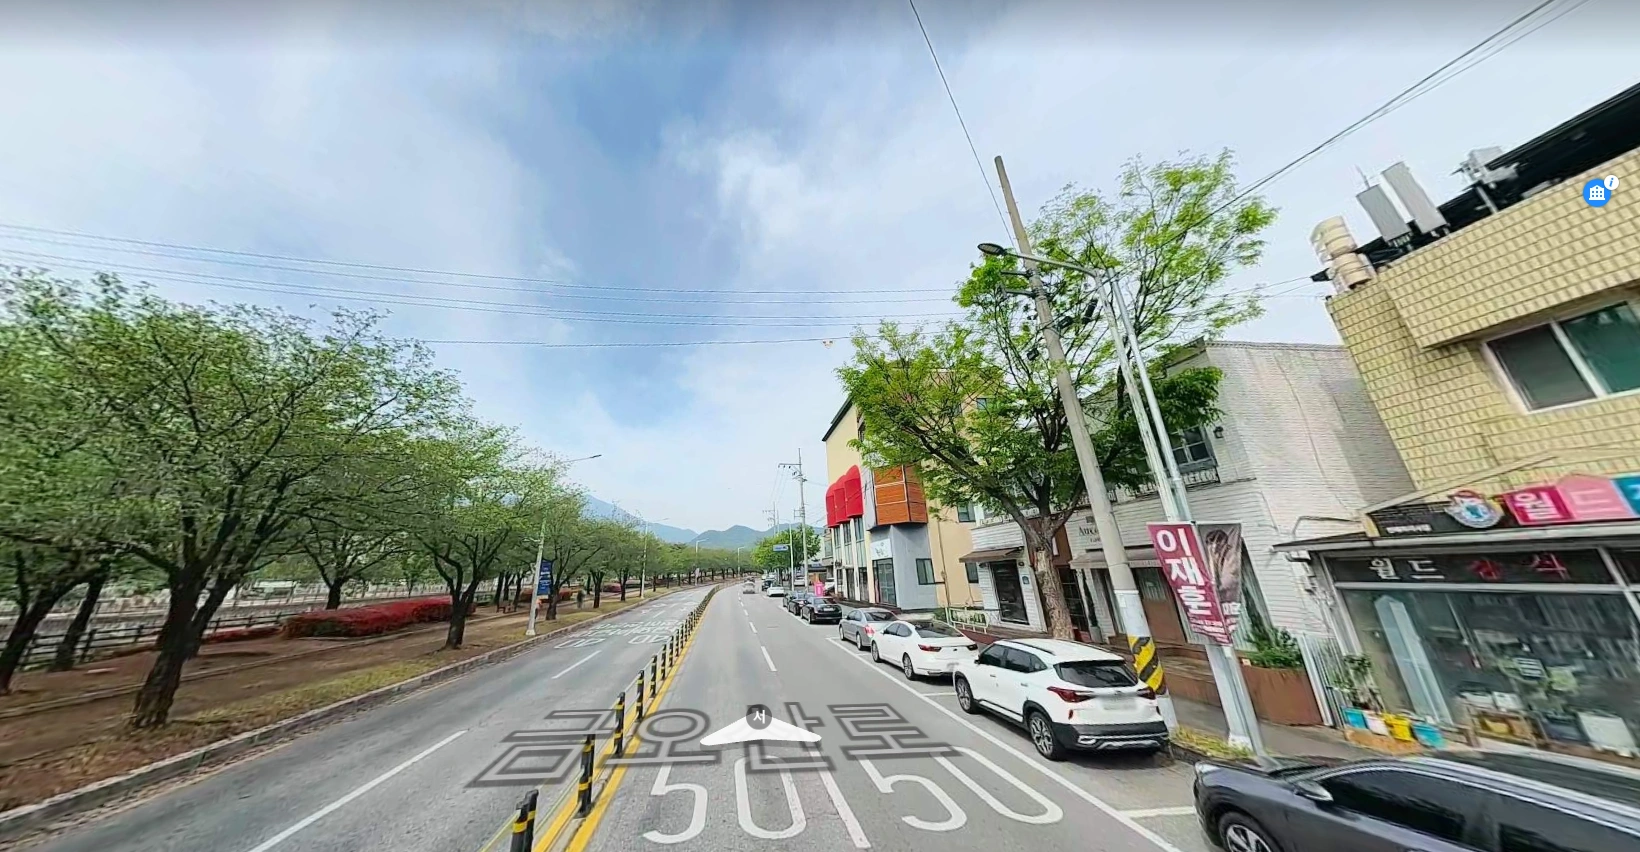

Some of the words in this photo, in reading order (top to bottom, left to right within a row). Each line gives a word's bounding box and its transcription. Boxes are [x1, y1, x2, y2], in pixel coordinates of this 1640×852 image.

[1513, 489, 1622, 519] 월드
[1156, 528, 1212, 615] 이재훈
[1368, 556, 1445, 581] 월드
[643, 752, 807, 844] 50
[850, 746, 1064, 832] 50
